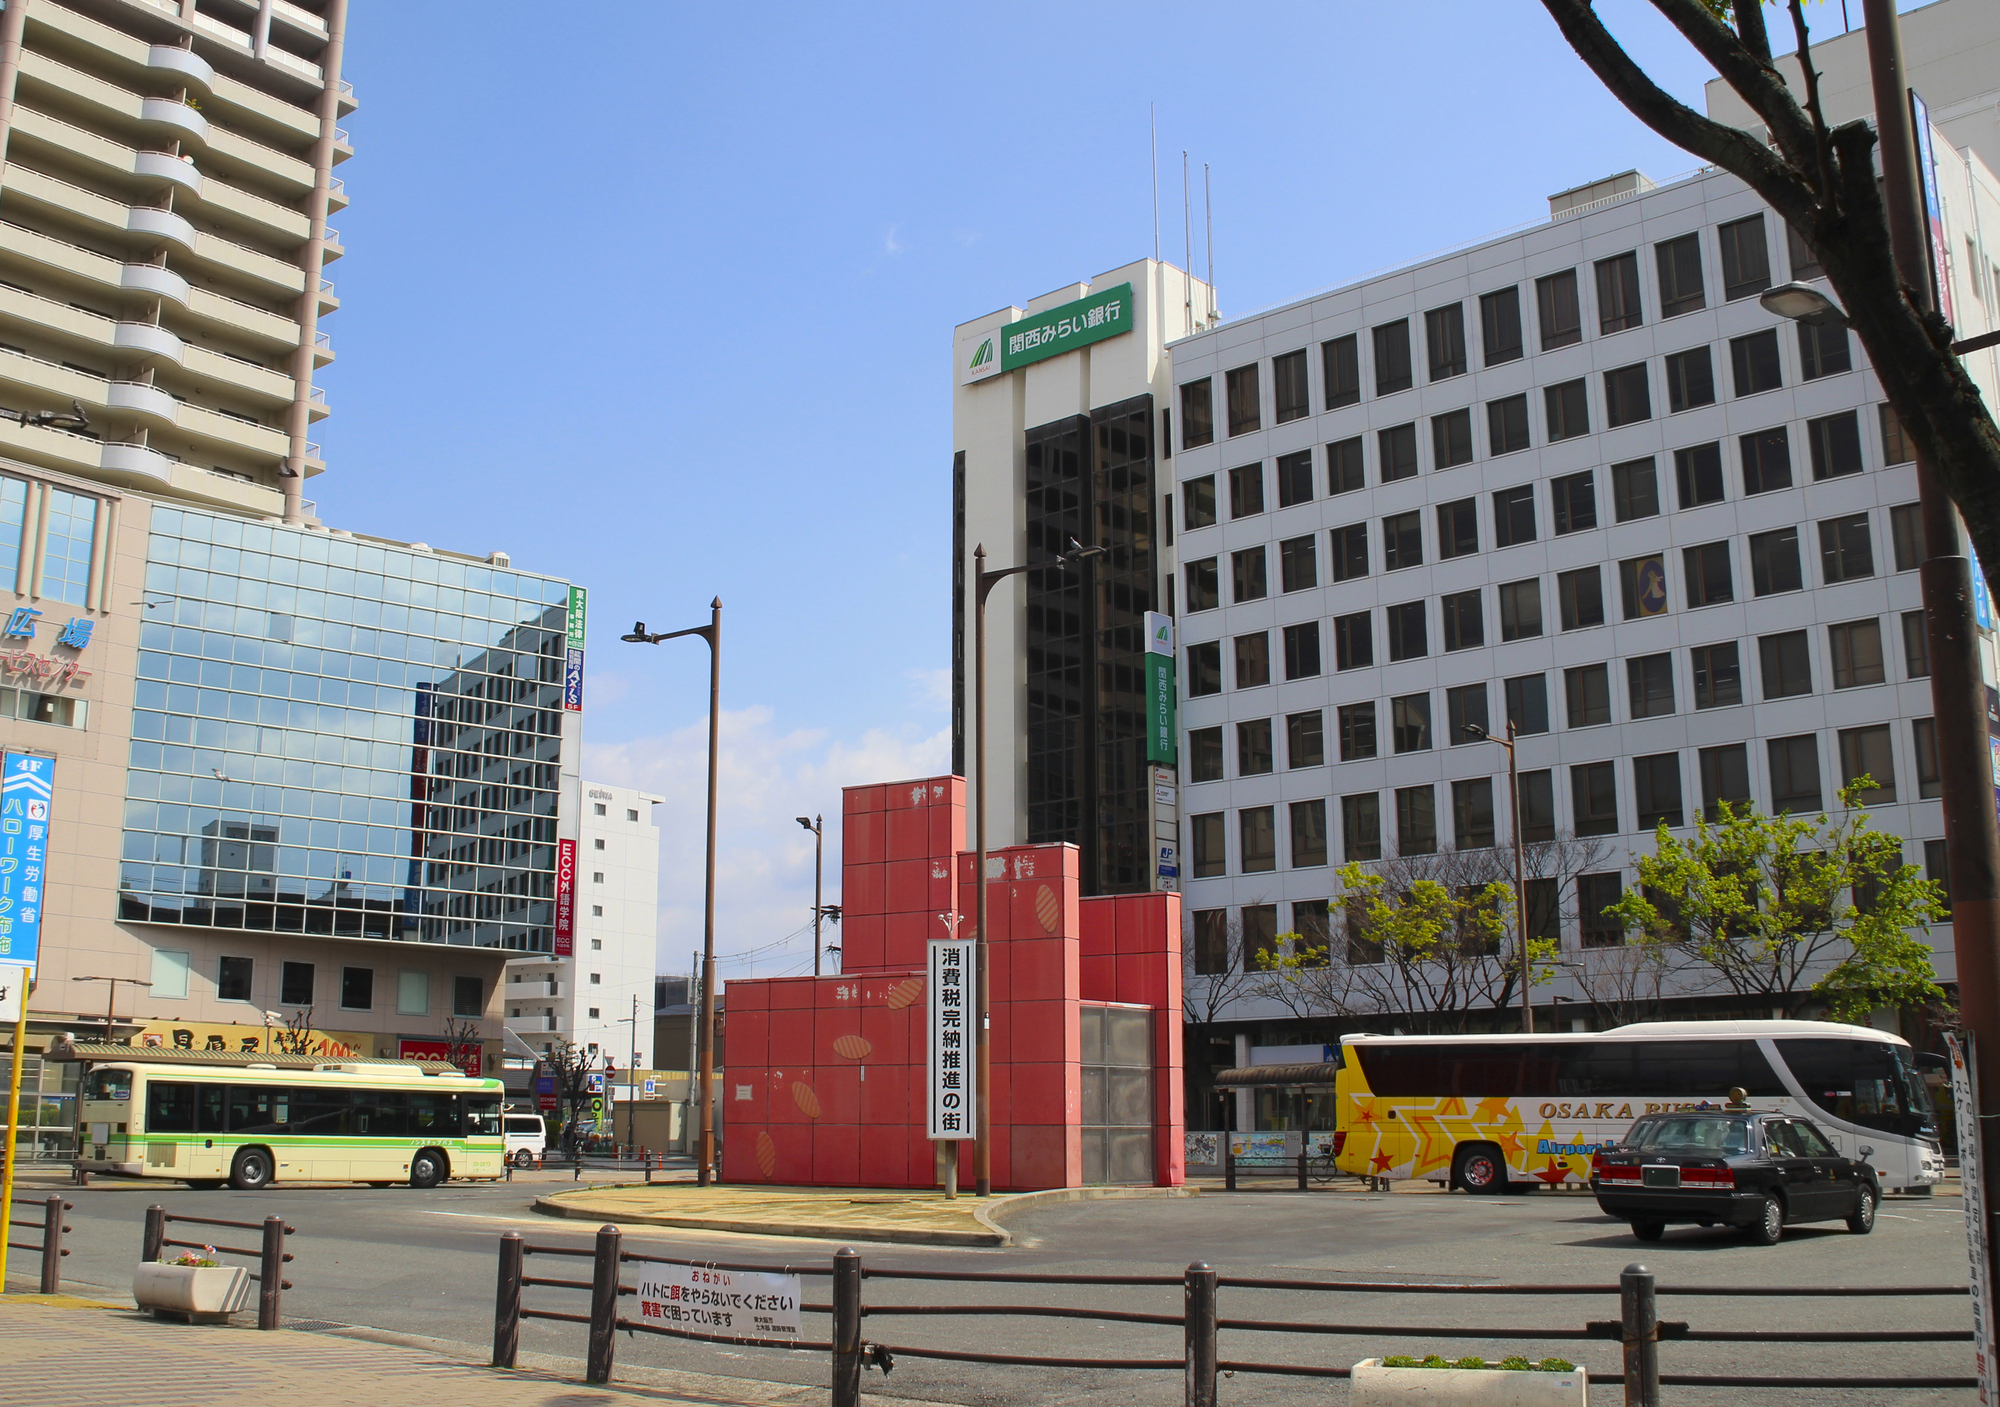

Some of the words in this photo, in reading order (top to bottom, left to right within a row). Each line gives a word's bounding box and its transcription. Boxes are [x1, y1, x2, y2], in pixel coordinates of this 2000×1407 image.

[1009, 300, 1121, 355] 関西みらい銀行
[971, 365, 991, 375] KANSAI
[1158, 666, 1168, 751] 関西みらい銀行
[16, 759, 43, 773] 4F
[1160, 847, 1173, 858] JP
[20, 824, 44, 923] 厚生労働省
[558, 843, 572, 931] ECC外語学院
[942, 947, 961, 1131] 消費税完納推進の街
[1538, 1102, 1634, 1119] OSAKA
[691, 1271, 731, 1285] おねがい
[641, 1282, 793, 1311] ハトに餌をやらないでください
[641, 1300, 733, 1327] 糞害で困っています
